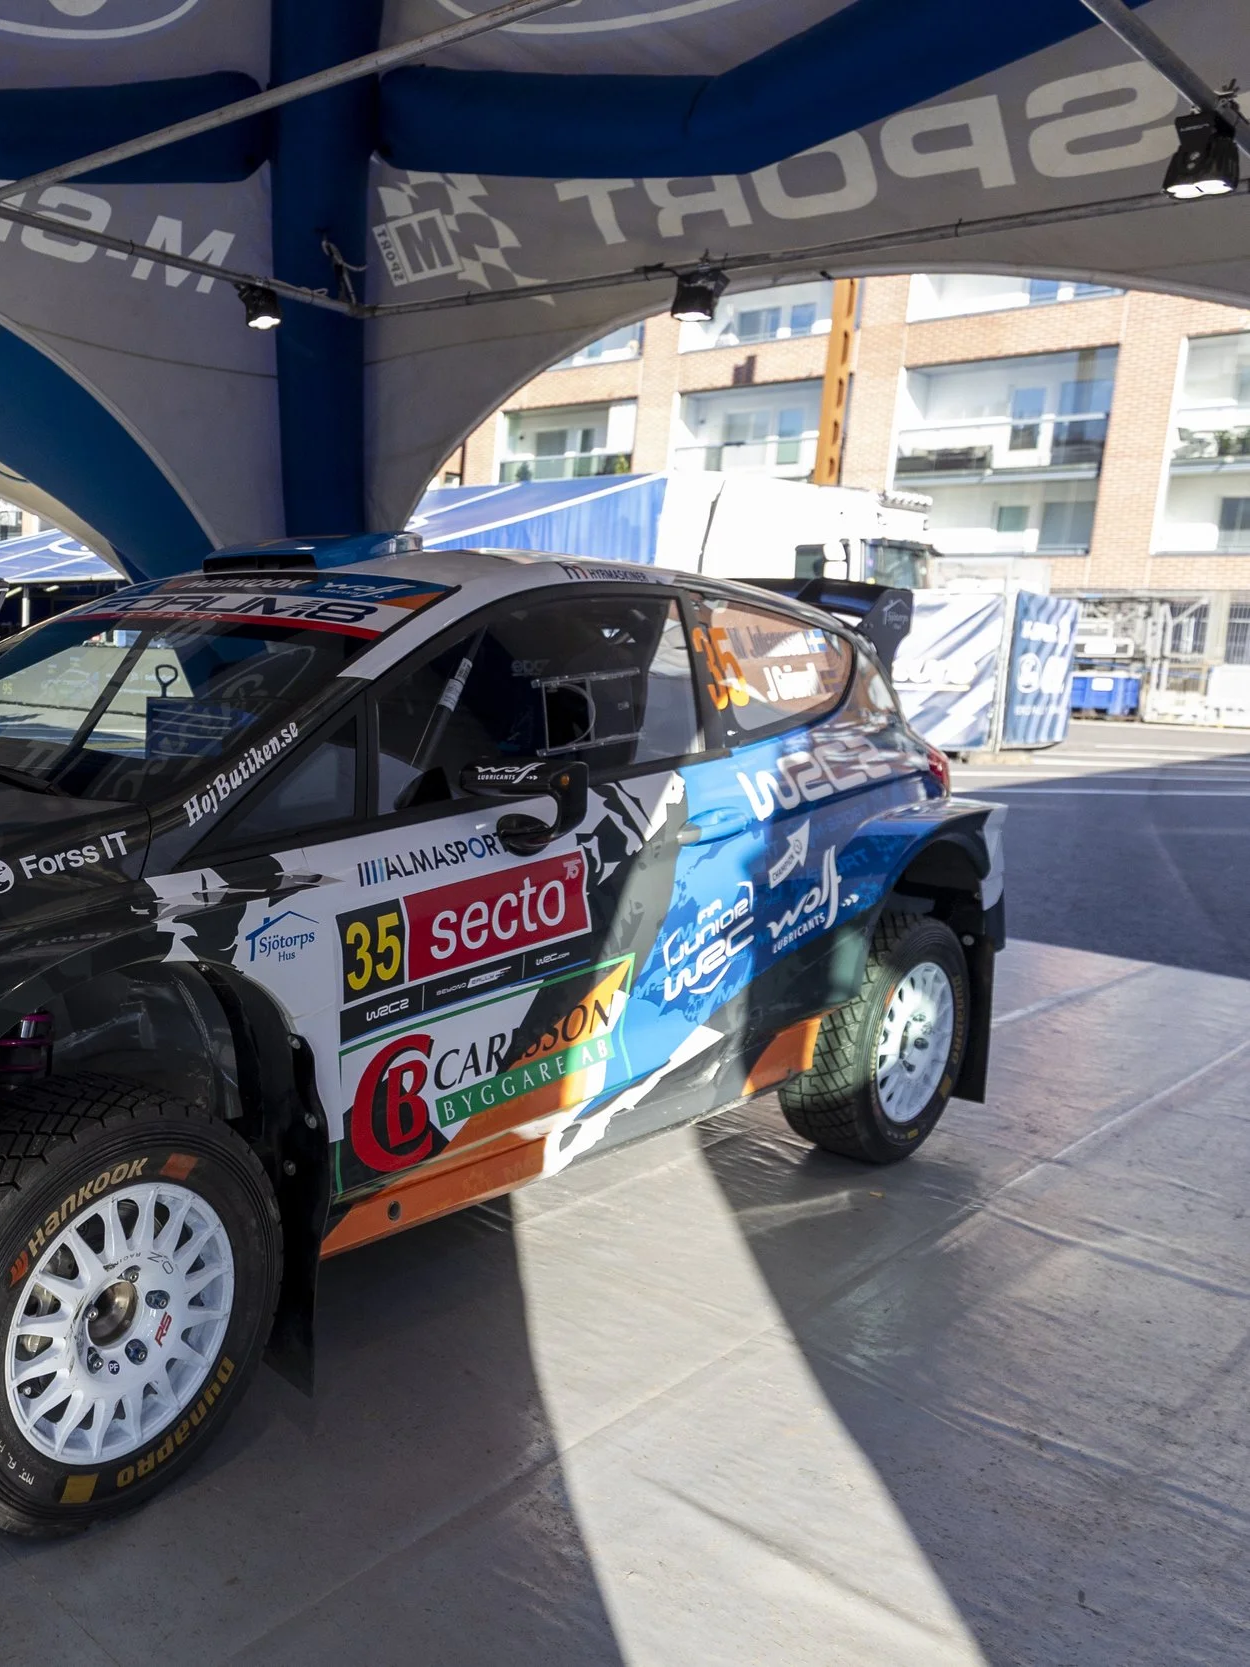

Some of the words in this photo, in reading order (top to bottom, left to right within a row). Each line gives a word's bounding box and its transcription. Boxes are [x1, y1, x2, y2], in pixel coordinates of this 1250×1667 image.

[692, 626, 750, 710] 35
[19, 844, 100, 880] Forss
[100, 830, 128, 860] IT
[430, 876, 566, 960] secto
[772, 911, 827, 954] LUBRICANTS
[259, 931, 316, 958] Sjötorps
[278, 951, 296, 962] Hus
[346, 911, 401, 991] 35
[366, 997, 410, 1022] WRC2
[443, 1056, 567, 1122] BYGGARE
[581, 1037, 609, 1069] AB
[154, 1311, 172, 1348] RS
[108, 1362, 120, 1373] PF
